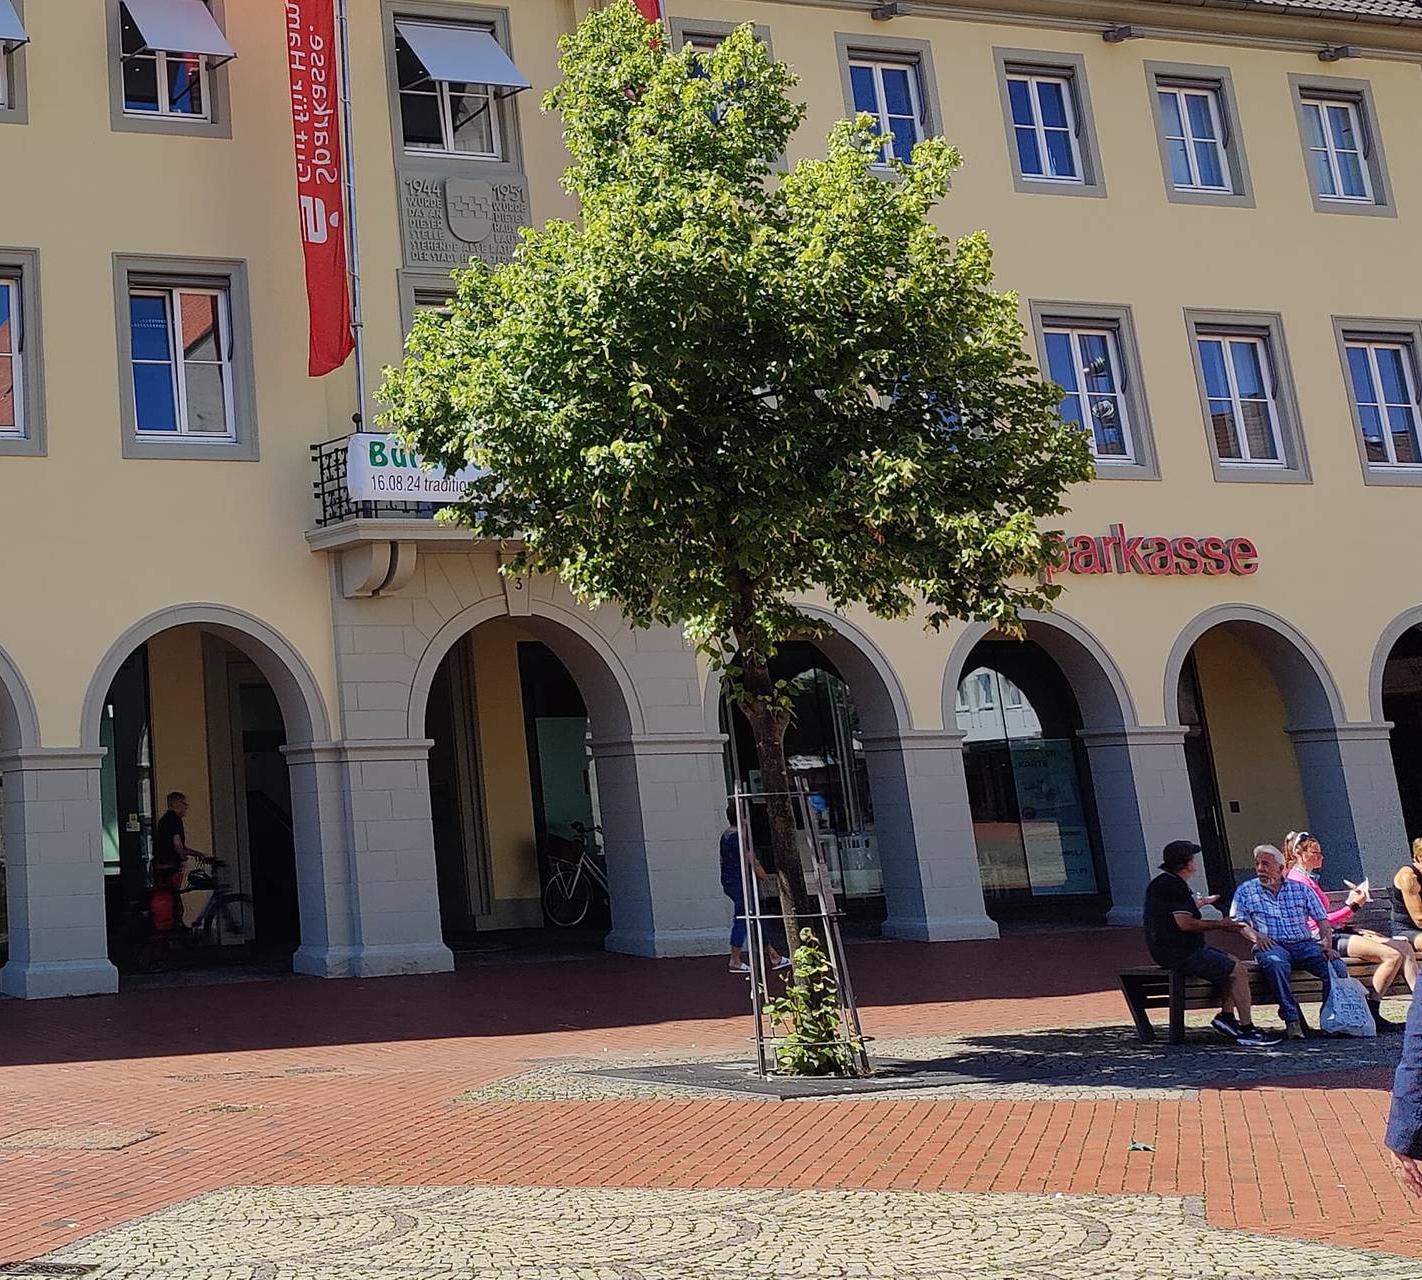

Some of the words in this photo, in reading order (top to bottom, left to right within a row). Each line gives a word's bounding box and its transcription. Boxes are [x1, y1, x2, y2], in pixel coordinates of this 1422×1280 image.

[405, 179, 442, 197] 1944
[492, 184, 525, 203] 1951
[406, 197, 442, 208] WURDE
[492, 201, 527, 213] WURDE
[409, 219, 443, 229] DIESER
[410, 230, 445, 240] STELLE
[372, 474, 420, 492] 16.08.24
[424, 478, 467, 493] traditio
[1042, 522, 1259, 584] parkasse
[514, 577, 523, 590] 3
